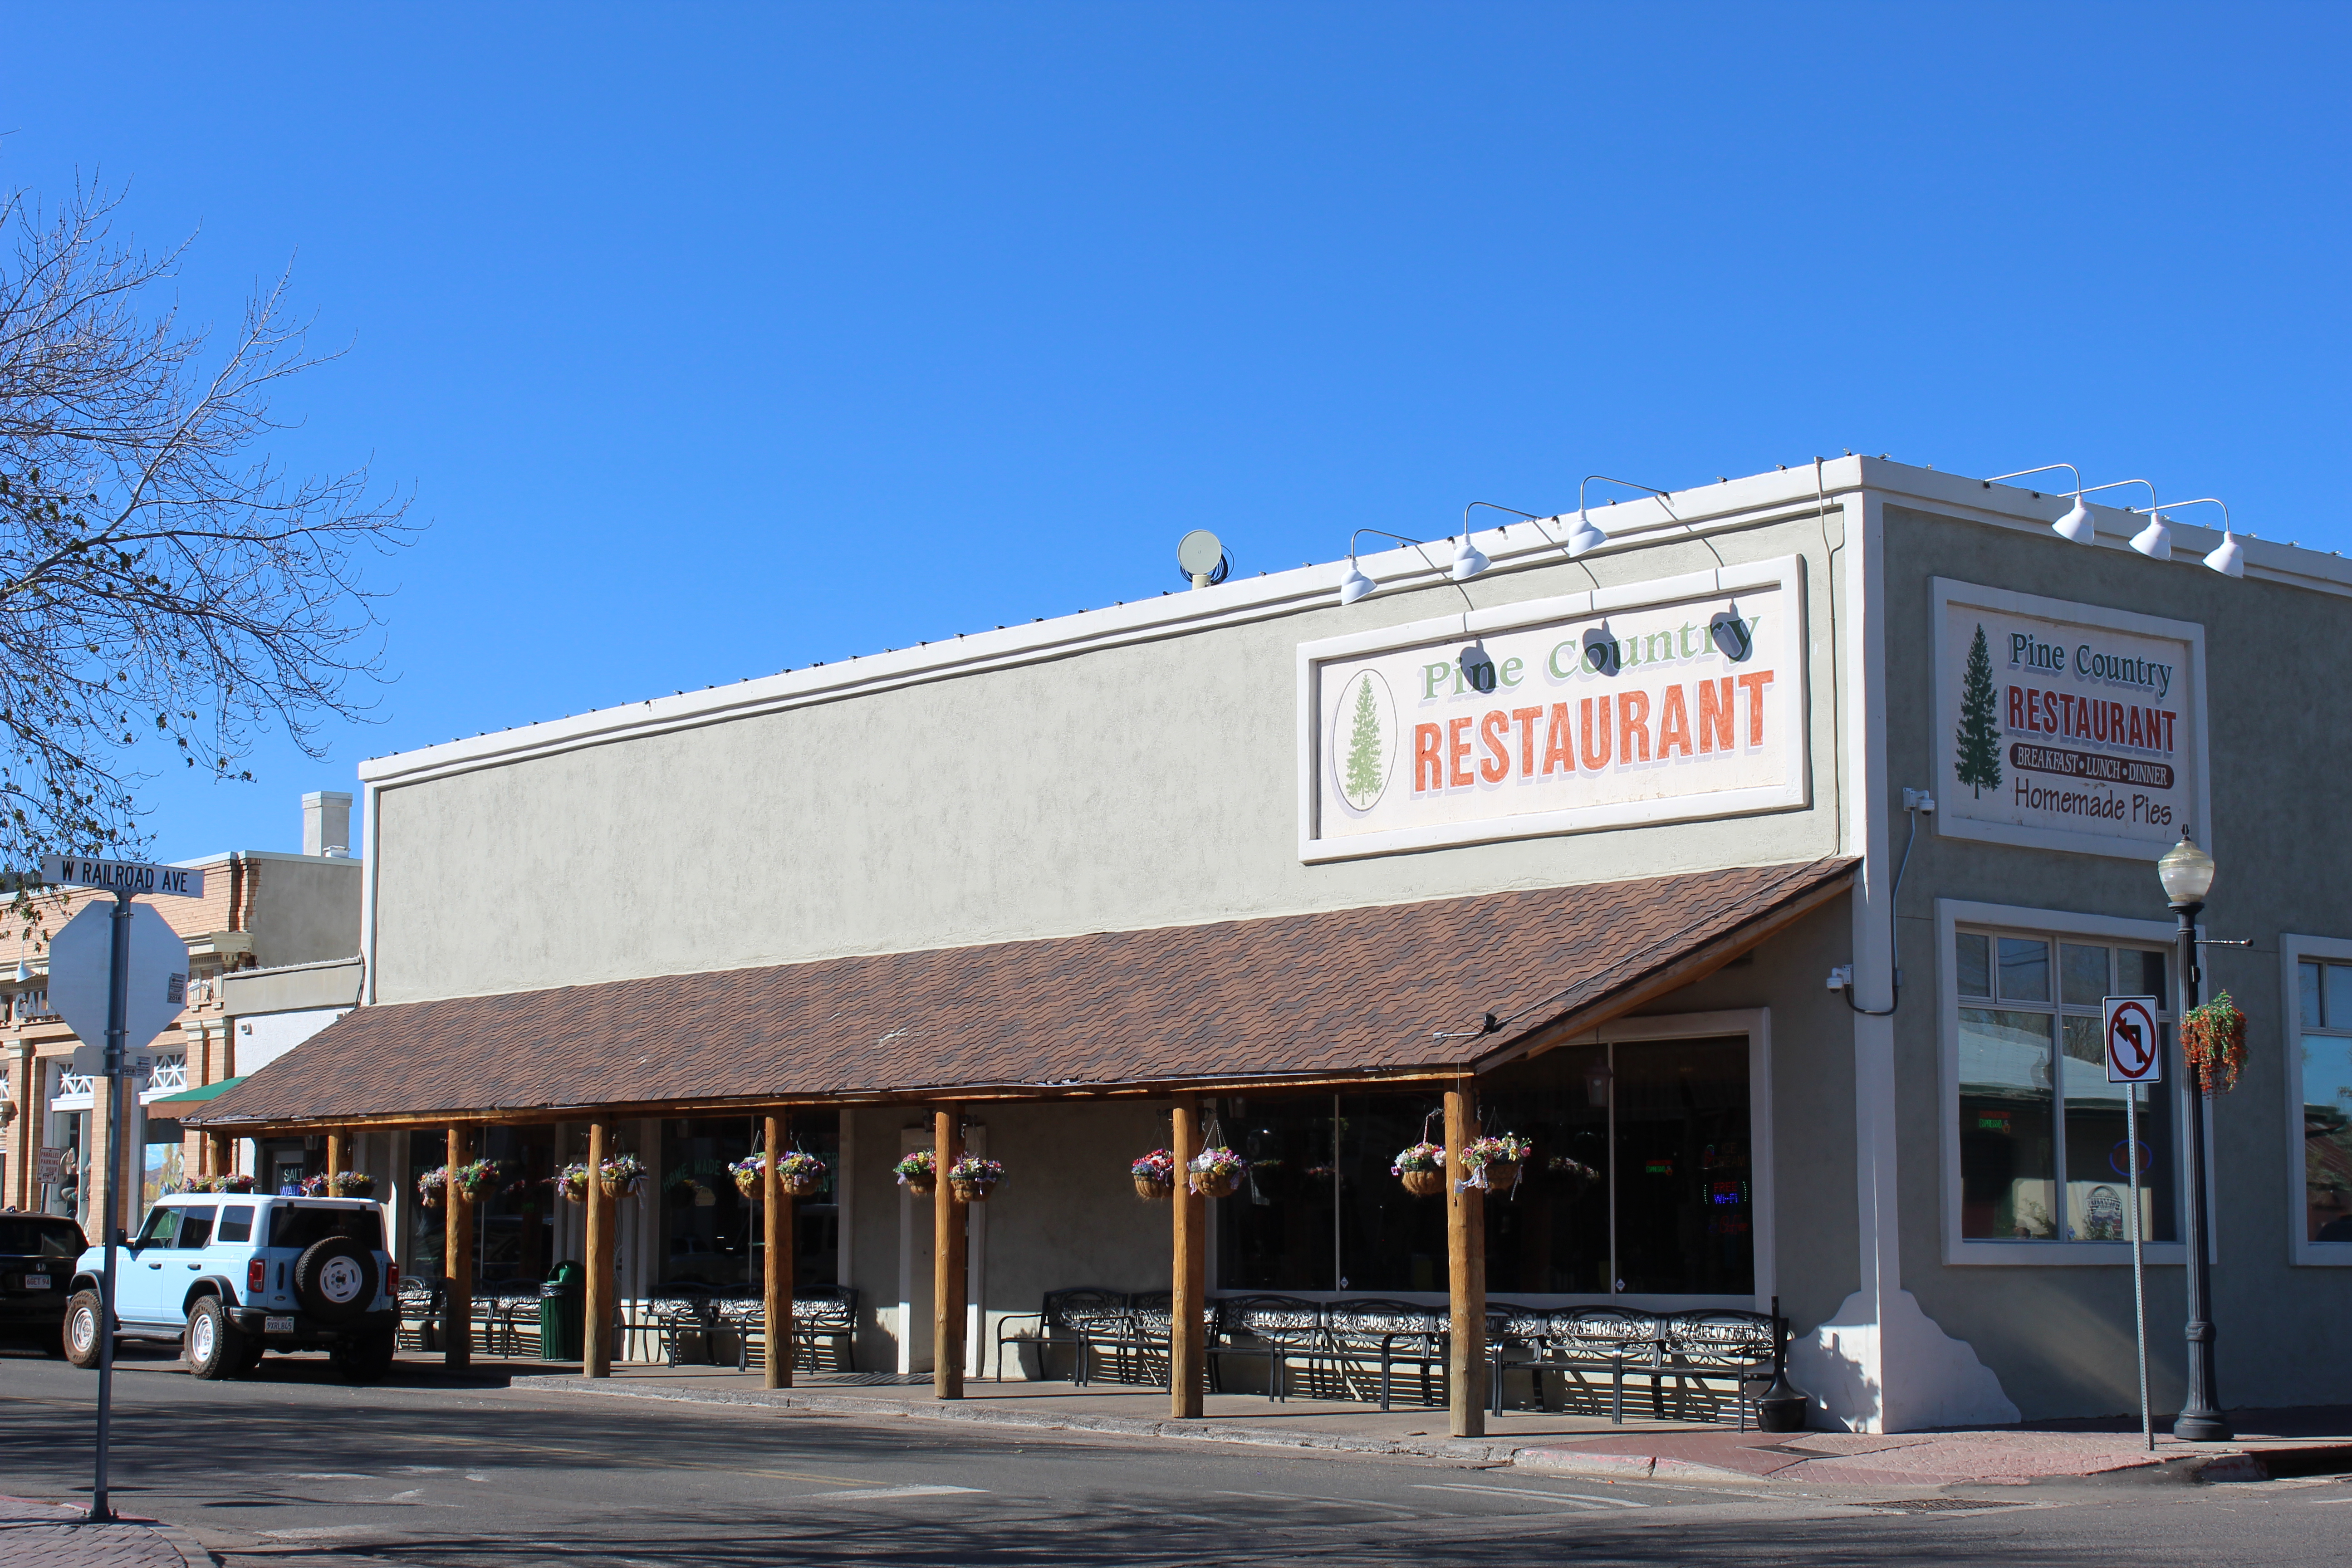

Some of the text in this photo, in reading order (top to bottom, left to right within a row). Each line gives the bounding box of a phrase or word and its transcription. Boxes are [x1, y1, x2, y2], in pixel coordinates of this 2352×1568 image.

[1423, 615, 1761, 700] Pine Country
[2009, 632, 2172, 698] Pine Country
[1414, 670, 1774, 793] RESTAURANT
[2008, 685, 2177, 753] RESTAURANT
[2017, 746, 2167, 786] BREAKFAST LUNCH DINNER
[2015, 777, 2172, 826] Homemade Pies
[63, 861, 188, 892] W RAILROAD AVE
[1713, 1155, 1746, 1168] CREAM
[1722, 1142, 1737, 1154] ICE
[284, 1168, 303, 1182] SALT
[662, 1159, 722, 1193] HOME MADE
[1713, 1181, 1738, 1192] FREE
[1719, 1215, 1749, 1235] Coffee
[267, 1322, 292, 1330] 9XRL845
